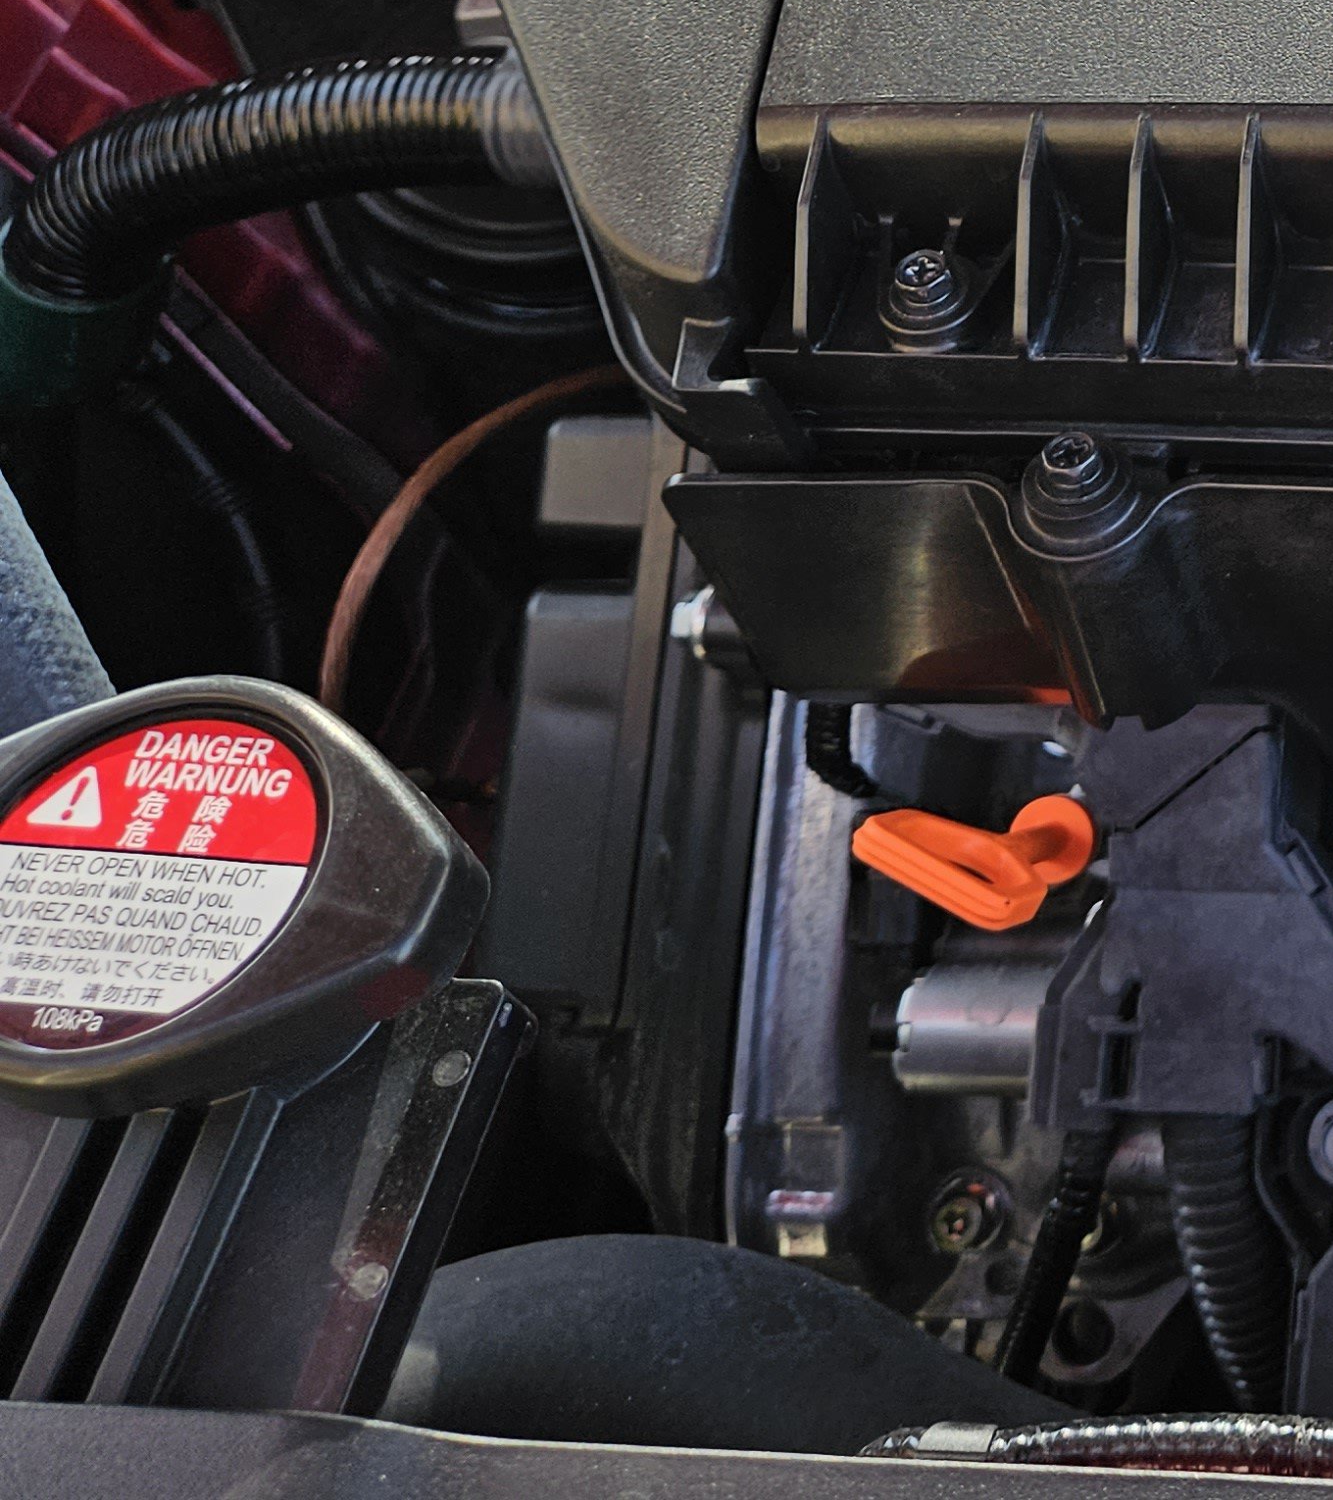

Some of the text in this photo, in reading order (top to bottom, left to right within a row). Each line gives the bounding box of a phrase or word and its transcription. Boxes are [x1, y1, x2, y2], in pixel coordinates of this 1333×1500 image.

[134, 730, 275, 767] DANGER
[124, 758, 293, 798] WARNUNG
[10, 851, 269, 890] NEVER OPEN WHEN HOT.
[0, 873, 235, 911] Hot coolant will scald you.
[0, 898, 264, 938] UVREZ PAS QUAND CHAUD.
[14, 925, 46, 947] BEI
[42, 927, 118, 951] HEISSEM
[114, 931, 179, 957] MOTOR
[177, 933, 245, 961] ÖFFNEN.
[31, 1005, 105, 1033] 108kPa
